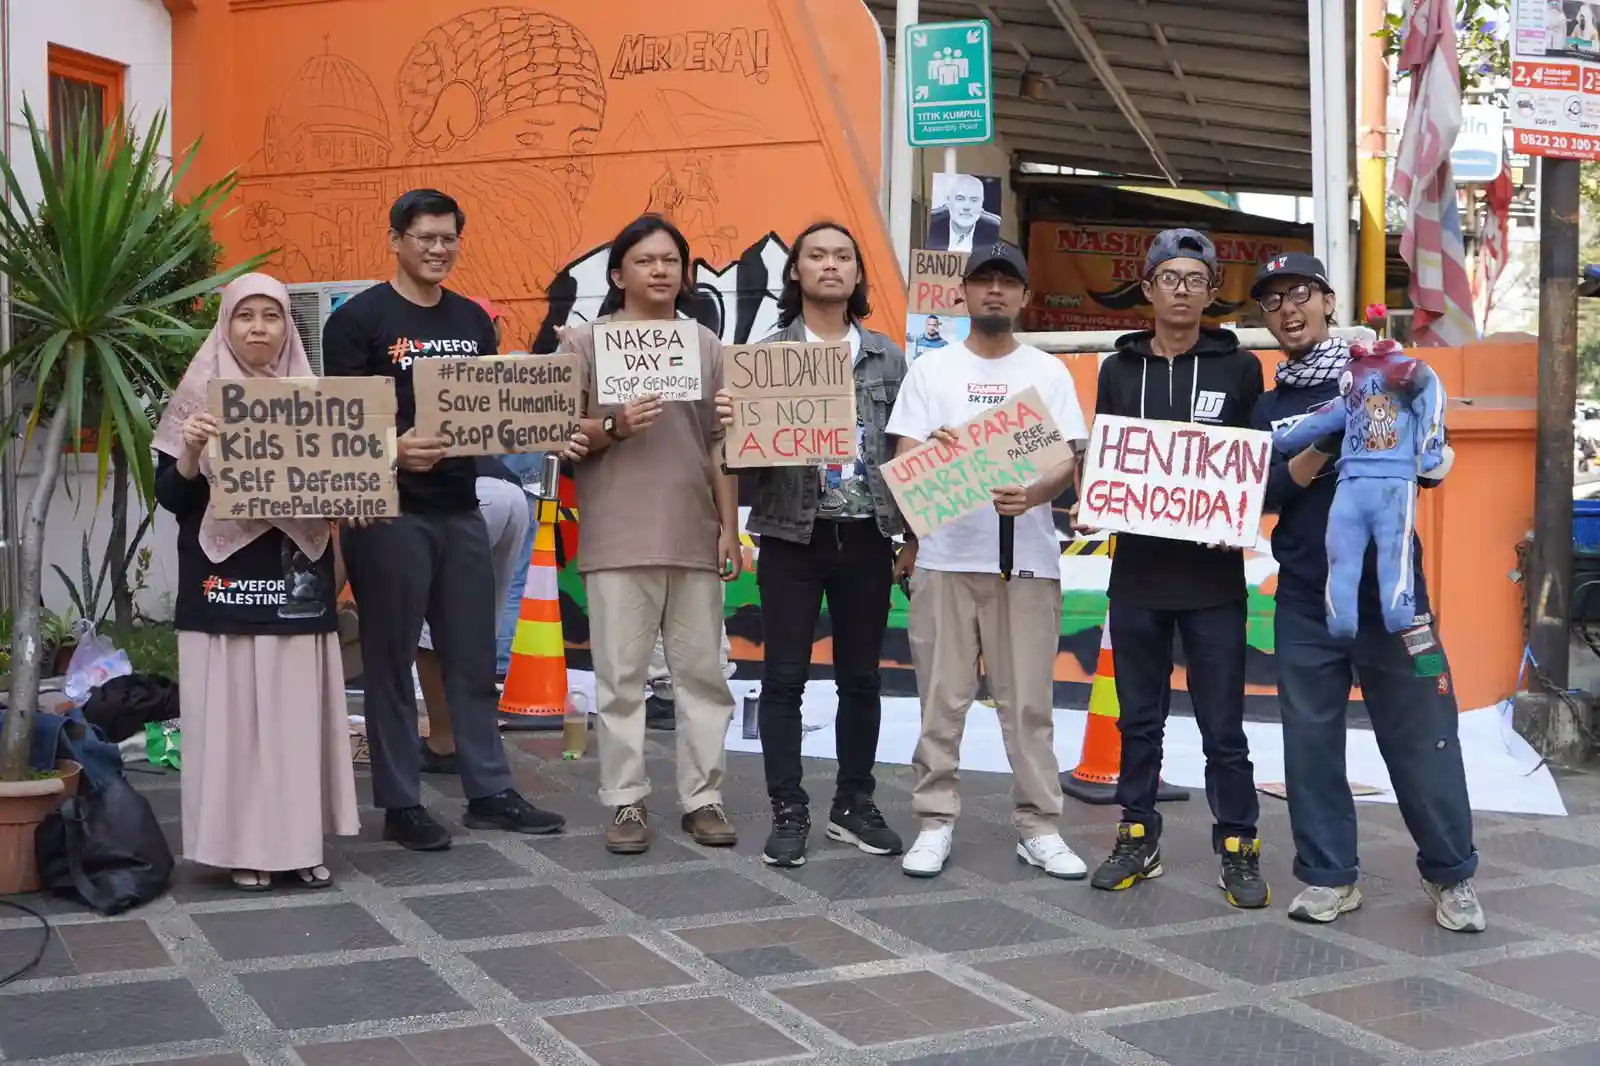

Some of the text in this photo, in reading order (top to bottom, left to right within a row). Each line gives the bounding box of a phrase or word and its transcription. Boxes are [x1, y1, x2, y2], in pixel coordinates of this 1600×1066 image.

[609, 27, 769, 84] MERDEKA!
[1514, 66, 1543, 86] 2,4
[917, 109, 983, 121] TITIK KUMPUL
[922, 124, 957, 133] Assembly
[1520, 133, 1550, 147] 0822
[1552, 136, 1567, 149] 20
[1057, 230, 1139, 255] NASI
[605, 328, 685, 351] NAKBA
[437, 362, 572, 386] #FreePalestine
[624, 353, 661, 372] DAY
[732, 347, 848, 389] SOLIDARITY
[603, 375, 700, 395] STOP GENOCIDE
[222, 384, 365, 431] Bombing
[438, 388, 576, 417] Save Humanity
[740, 399, 837, 426] IS NOT
[440, 419, 581, 450] Stop Genocide
[967, 401, 1044, 447] PARA
[1013, 423, 1047, 446] FREE
[220, 427, 383, 462] Kids is not
[738, 427, 849, 459] A CRIME
[1007, 430, 1062, 461] PALESTINE
[1099, 425, 1268, 484] HENTIKAN
[220, 466, 381, 494] Self Defense
[902, 449, 999, 511] MARTIR
[229, 495, 388, 518] #FreePalestine
[1086, 480, 1248, 536] GENOSIDA!
[208, 592, 289, 605] PALESTINE
